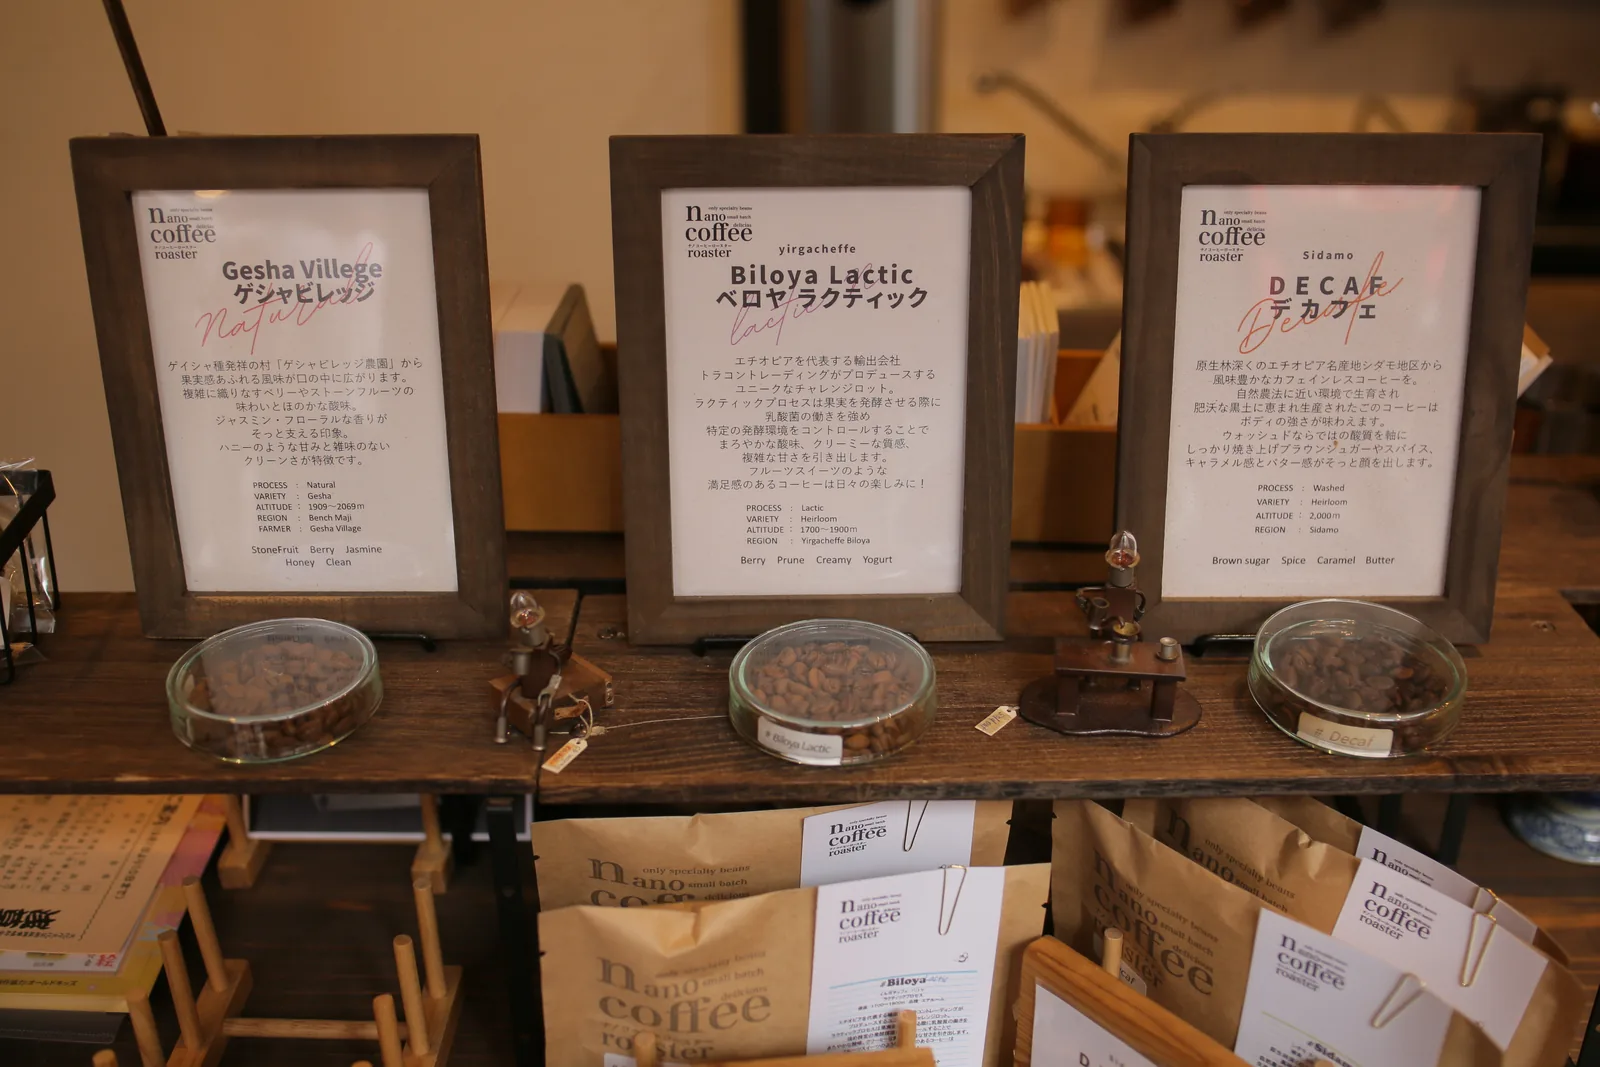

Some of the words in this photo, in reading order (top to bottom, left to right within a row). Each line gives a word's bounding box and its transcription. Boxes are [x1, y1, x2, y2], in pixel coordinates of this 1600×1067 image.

[148, 207, 189, 223] nano
[685, 205, 726, 222] nano
[1200, 210, 1240, 226] nano
[150, 224, 216, 243] coffee
[685, 222, 753, 242] coffee
[1198, 226, 1266, 246] coffee
[155, 250, 198, 259] roaster
[688, 248, 732, 258] roaster
[778, 243, 856, 256] yirgacheffe
[1303, 250, 1354, 260] Sidamo
[1200, 252, 1243, 262] roaster
[222, 260, 295, 280] Gesha
[299, 258, 383, 288] Villege
[731, 264, 818, 290] Biloya
[830, 263, 914, 285] Lactic
[1270, 276, 1383, 295] DECAF
[233, 281, 375, 305] ゲシャビレッジ
[1270, 297, 1376, 320] デカフェ
[168, 357, 423, 373] ゲイシャ種発祥の村「ゲシャビレッジ農園」から
[735, 354, 901, 367] エチオピアを代表する輸出会社
[1196, 360, 1442, 372] 原生林深くのエチオピア名産地シダモ地区から
[181, 372, 408, 386] 果実感あふれる風味が口の中に広がります。
[701, 369, 936, 381] トラコントレーディングがプロデュースする
[1213, 374, 1418, 386] 風味豊かなカフェインレスコーヒーを。
[183, 386, 414, 399] 複雑に織りなすベリーやストーンフルーツの
[735, 383, 896, 395] ユニークなチャレンジロット。
[1237, 388, 1400, 399] 自然農法に近い環境で生育され
[236, 400, 357, 412] 味わいとほのかな酸味。
[695, 397, 941, 409] ラクティックプロセスは果実を発酵させる際に
[216, 413, 388, 426] ジャスミン・フローラルな香りが
[765, 411, 871, 423] 乳酸菌の働きを強め
[1240, 416, 1385, 428] ボディの強さが味わえます。
[252, 428, 349, 440] そっと支える印象。
[706, 425, 929, 437] 特定の発酵環境をコントロールすることで
[1222, 430, 1407, 441] ウォッシュドならではの酸質を軸に
[219, 441, 390, 453] ハニーのような甘みと雑味のない
[719, 438, 911, 450] まろやかな酸味、クリーミーな質感、
[1187, 443, 1433, 456] しっかり焼き上げブラウンシュガーやスパイス、
[244, 454, 364, 466] クリーンさが特徴です。
[742, 452, 889, 464] 複雑な甘さを引き出します。
[1185, 457, 1433, 469] キャラメル感とバター感がそっと顔を出します。
[749, 466, 888, 477] フルーツスイーツのような
[253, 481, 288, 489] PROCESS
[306, 481, 336, 489] Natural
[1313, 484, 1345, 492] Washed
[307, 492, 332, 500] Gesha
[1256, 498, 1290, 506] VARIETY
[1311, 498, 1347, 506] Heirloom
[256, 503, 293, 511] ALTITUDE
[746, 504, 782, 512] PROCESS
[801, 504, 824, 512] Lactic
[257, 514, 288, 522] REGION
[308, 514, 333, 522] Bench
[334, 514, 352, 523] Maji
[746, 515, 779, 523] VARIETY
[800, 515, 838, 523] Heirloom
[1255, 512, 1293, 520] ALTITUDE
[258, 525, 291, 533] FARMER
[310, 525, 334, 533] Gesha
[335, 525, 362, 534] Village
[746, 526, 784, 534] ALTITUDE
[1254, 526, 1286, 534] REGION
[1309, 526, 1339, 534] Sidamo
[746, 537, 778, 545] REGION
[801, 537, 845, 546] Yirgacheffe
[846, 537, 871, 546] Biloya
[251, 546, 299, 554] StoneFruit
[309, 546, 335, 555] Berry
[345, 545, 383, 554] Jasmine
[285, 559, 315, 568] Honey
[325, 558, 352, 566] Clean
[740, 556, 766, 566] Berry
[777, 556, 805, 564] Prune
[816, 555, 852, 565] Creamy
[863, 555, 893, 565] Yogurt
[1212, 557, 1242, 565] Brown
[1245, 558, 1270, 567] sugar
[1281, 556, 1306, 566] Spice
[1317, 556, 1356, 565] Caramel
[1365, 556, 1395, 565] Butter
[773, 732, 800, 750] Biloya
[801, 741, 832, 753] Lactic
[1329, 731, 1375, 747] Decaf
[829, 828, 887, 847] coffee
[829, 844, 867, 857] roaster
[588, 858, 685, 891] nano
[643, 867, 666, 875] only
[669, 866, 717, 876] specialty
[719, 864, 750, 873] beans
[1204, 838, 1224, 855] only
[1226, 852, 1265, 882] specialty
[1266, 878, 1296, 899] beans
[688, 880, 716, 889] small
[719, 878, 748, 887] batch
[1146, 896, 1188, 924] specialty
[839, 909, 901, 930] coffee
[1364, 899, 1431, 940] coffee
[1160, 922, 1185, 939] small
[1359, 914, 1403, 940] roaster
[838, 930, 879, 943] roaster
[1094, 884, 1214, 996] coffee
[702, 974, 732, 987] small
[734, 967, 764, 980] batch
[1277, 952, 1345, 991] coffee
[598, 995, 771, 1034] coffee
[602, 1032, 715, 1061] roster
